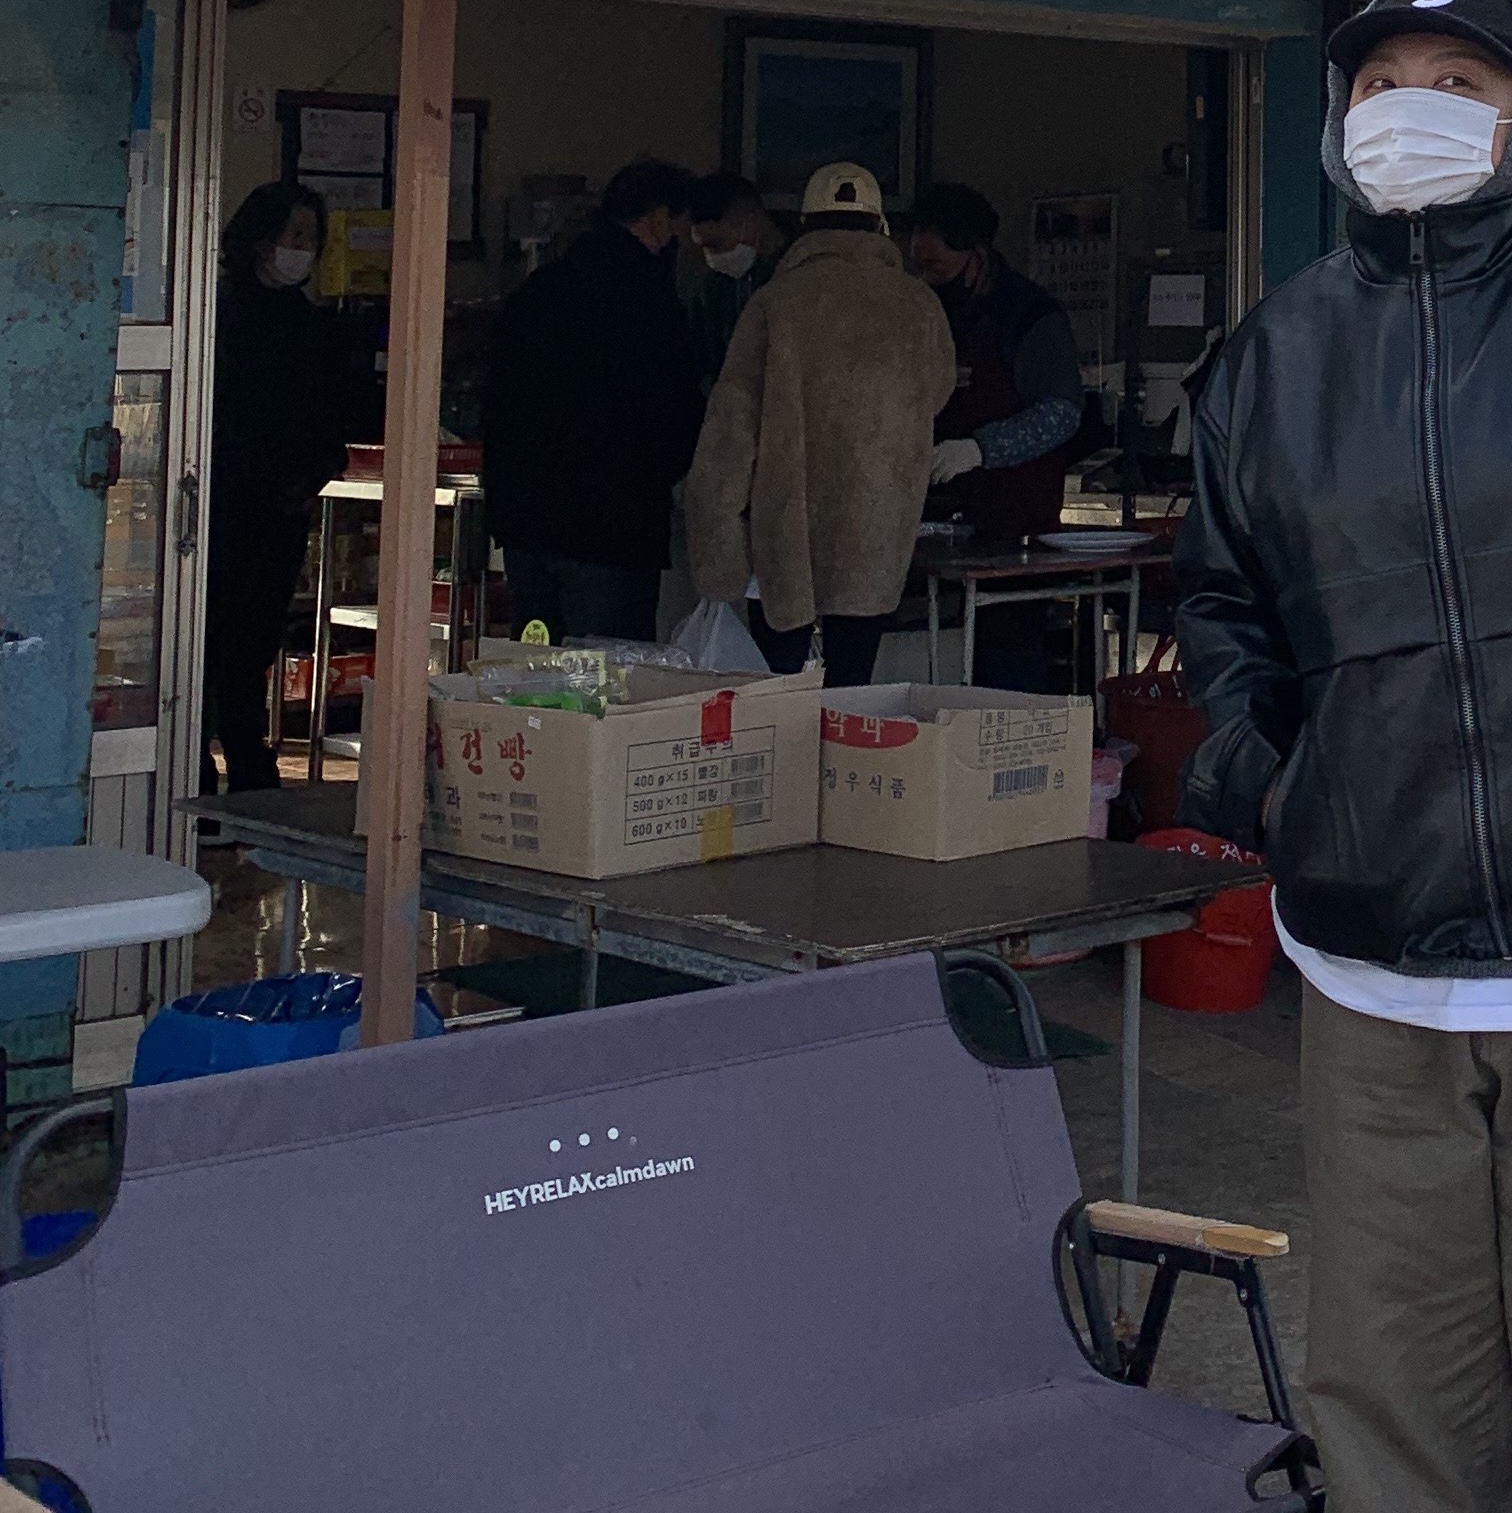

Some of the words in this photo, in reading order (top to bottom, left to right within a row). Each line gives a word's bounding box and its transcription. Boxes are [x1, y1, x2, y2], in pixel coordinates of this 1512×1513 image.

[633, 775, 654, 788] 400
[631, 799, 653, 812] 500
[631, 823, 652, 837] 600
[484, 1155, 695, 1215] HEYRELAXcalmdawn
